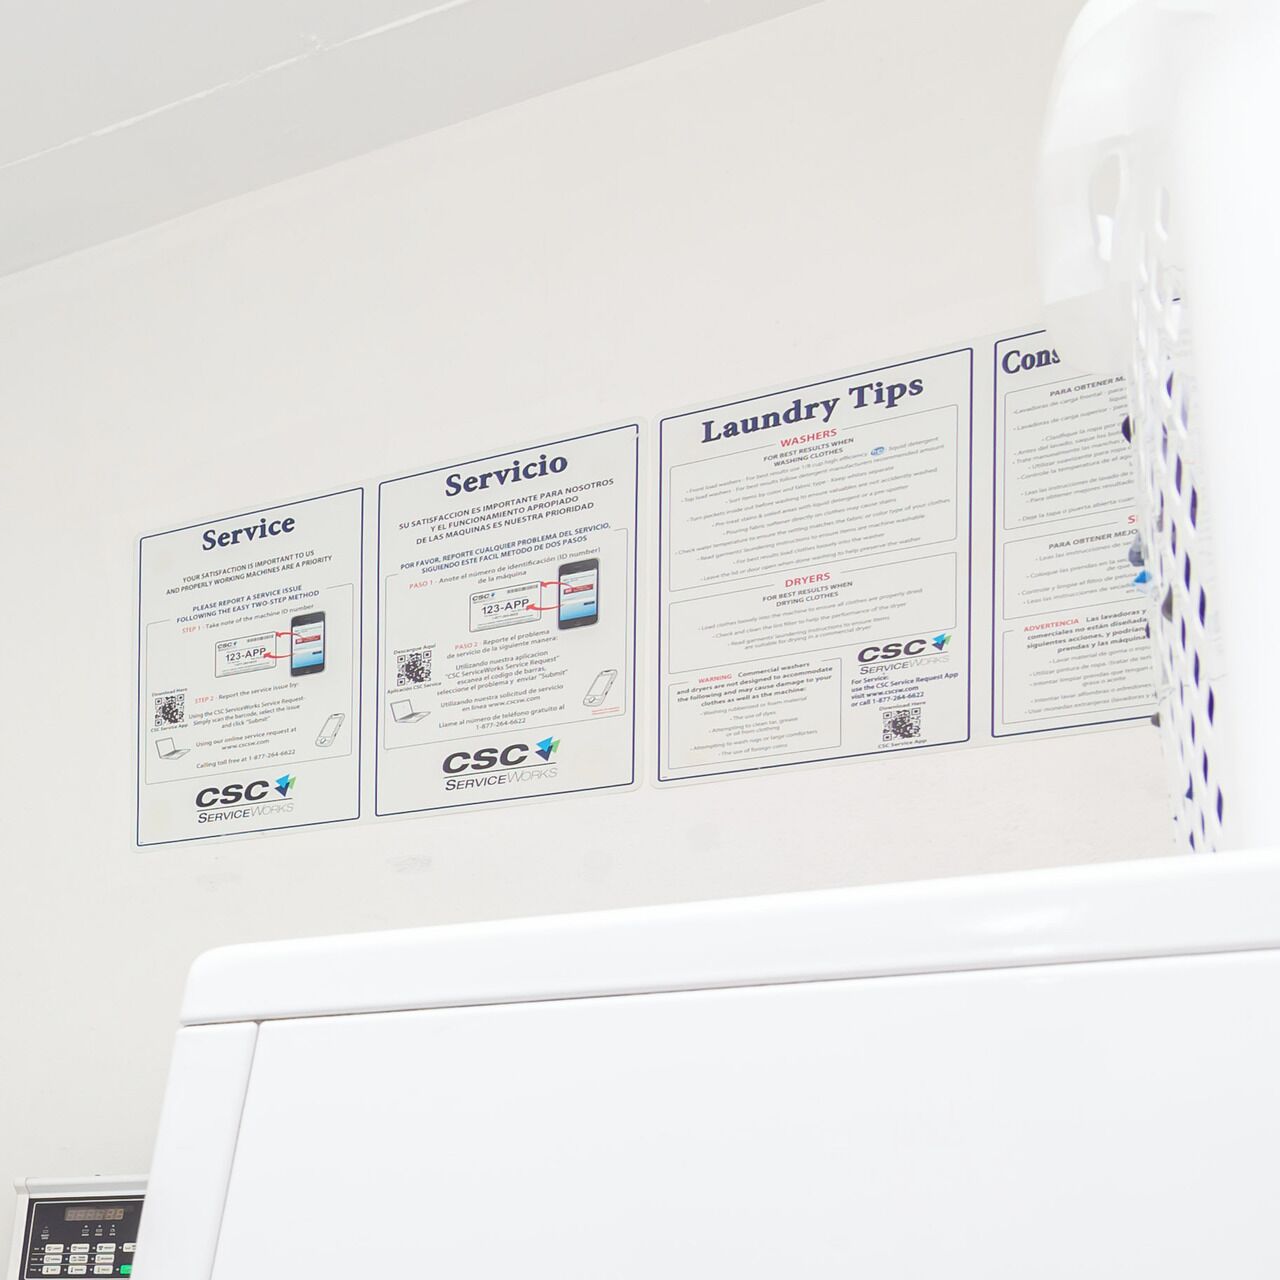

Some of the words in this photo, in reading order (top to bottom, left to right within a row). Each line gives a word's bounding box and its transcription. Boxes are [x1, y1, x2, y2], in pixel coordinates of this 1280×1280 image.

[1049, 387, 1072, 397] PARA
[1074, 378, 1113, 392] OBTENER
[701, 397, 840, 444] Laundry
[848, 379, 924, 409] Tips
[763, 454, 778, 462] FOR
[779, 449, 797, 458] BEST
[798, 443, 830, 454] RESULTS
[830, 437, 854, 447] WHEN
[780, 428, 837, 448] WASHERS
[773, 454, 809, 467] WASHING
[810, 447, 844, 459] CLOTHES
[445, 454, 568, 497] Servicio
[399, 522, 410, 530] SU
[411, 509, 470, 528] SATISFACCION
[471, 506, 481, 514] ES
[483, 494, 538, 512] IMPORTANTE
[540, 489, 563, 500] PARA
[565, 478, 614, 494] NOSOTROS
[448, 507, 525, 529] FUNCIONAMIENTO
[527, 495, 579, 512] APROPIADO
[202, 517, 295, 551] Service
[416, 537, 427, 545] DE
[428, 533, 444, 542] LAS
[445, 523, 491, 539] MAQUINAS
[492, 521, 503, 529] ES
[504, 512, 544, 527] NUESTRA
[545, 502, 594, 518] PRIORIDAD
[400, 562, 415, 570] POR
[442, 549, 474, 562] REPORTE
[474, 541, 516, 555] CUALQUIER
[517, 533, 557, 547] PROBLEMA
[559, 530, 573, 538] DEL
[421, 560, 460, 574] SIGUIENDO
[461, 557, 478, 566] ESTE
[479, 553, 499, 562] FACIL
[500, 546, 533, 558] METODO
[534, 543, 544, 552] DE
[545, 540, 561, 549] DOS
[562, 535, 588, 546] PASOS
[166, 587, 180, 595] AND
[181, 580, 213, 592] PROPERLY
[214, 573, 245, 585] WORKING
[246, 566, 280, 579] MACHINES
[281, 563, 294, 571] ARE
[301, 555, 332, 567] PRIORITY
[183, 574, 200, 583] YOUR
[201, 564, 247, 580] SATISFACTION
[254, 554, 294, 568] IMPORTANT
[785, 572, 831, 588] DRYERS
[192, 602, 217, 612] PLEASE
[218, 596, 245, 607] REPORT
[252, 589, 281, 600] SERVICE
[282, 584, 302, 594] ISSUE
[762, 594, 777, 602] FOR
[778, 591, 796, 599] BEST
[798, 585, 829, 595] RESULTS
[830, 581, 853, 590] WHEN
[776, 596, 804, 607] DRYING
[805, 591, 839, 602] CLOTHES
[176, 610, 217, 623] FOLLOWING
[218, 607, 231, 615] THE
[232, 604, 250, 613] EASY
[251, 596, 287, 608] TWO-STEP
[288, 590, 320, 601] METHOD
[481, 598, 530, 615] 123-APP
[1100, 610, 1140, 620] lavadoras
[1024, 618, 1079, 632] ADVERTENCIA
[225, 647, 266, 662] 123-APP
[857, 639, 927, 663] CSC
[698, 673, 732, 684] WARNING
[738, 666, 779, 678] Commercial
[780, 662, 810, 671] washers
[739, 675, 772, 685] designed
[782, 667, 833, 679] accommodate
[875, 681, 889, 689] CSC
[890, 679, 914, 687] Service
[915, 674, 943, 683] Request
[690, 692, 722, 700] following
[723, 688, 737, 696] and
[775, 679, 805, 688] damage
[815, 675, 832, 683] your
[442, 743, 529, 774] CSC
[195, 780, 270, 808] CSC
